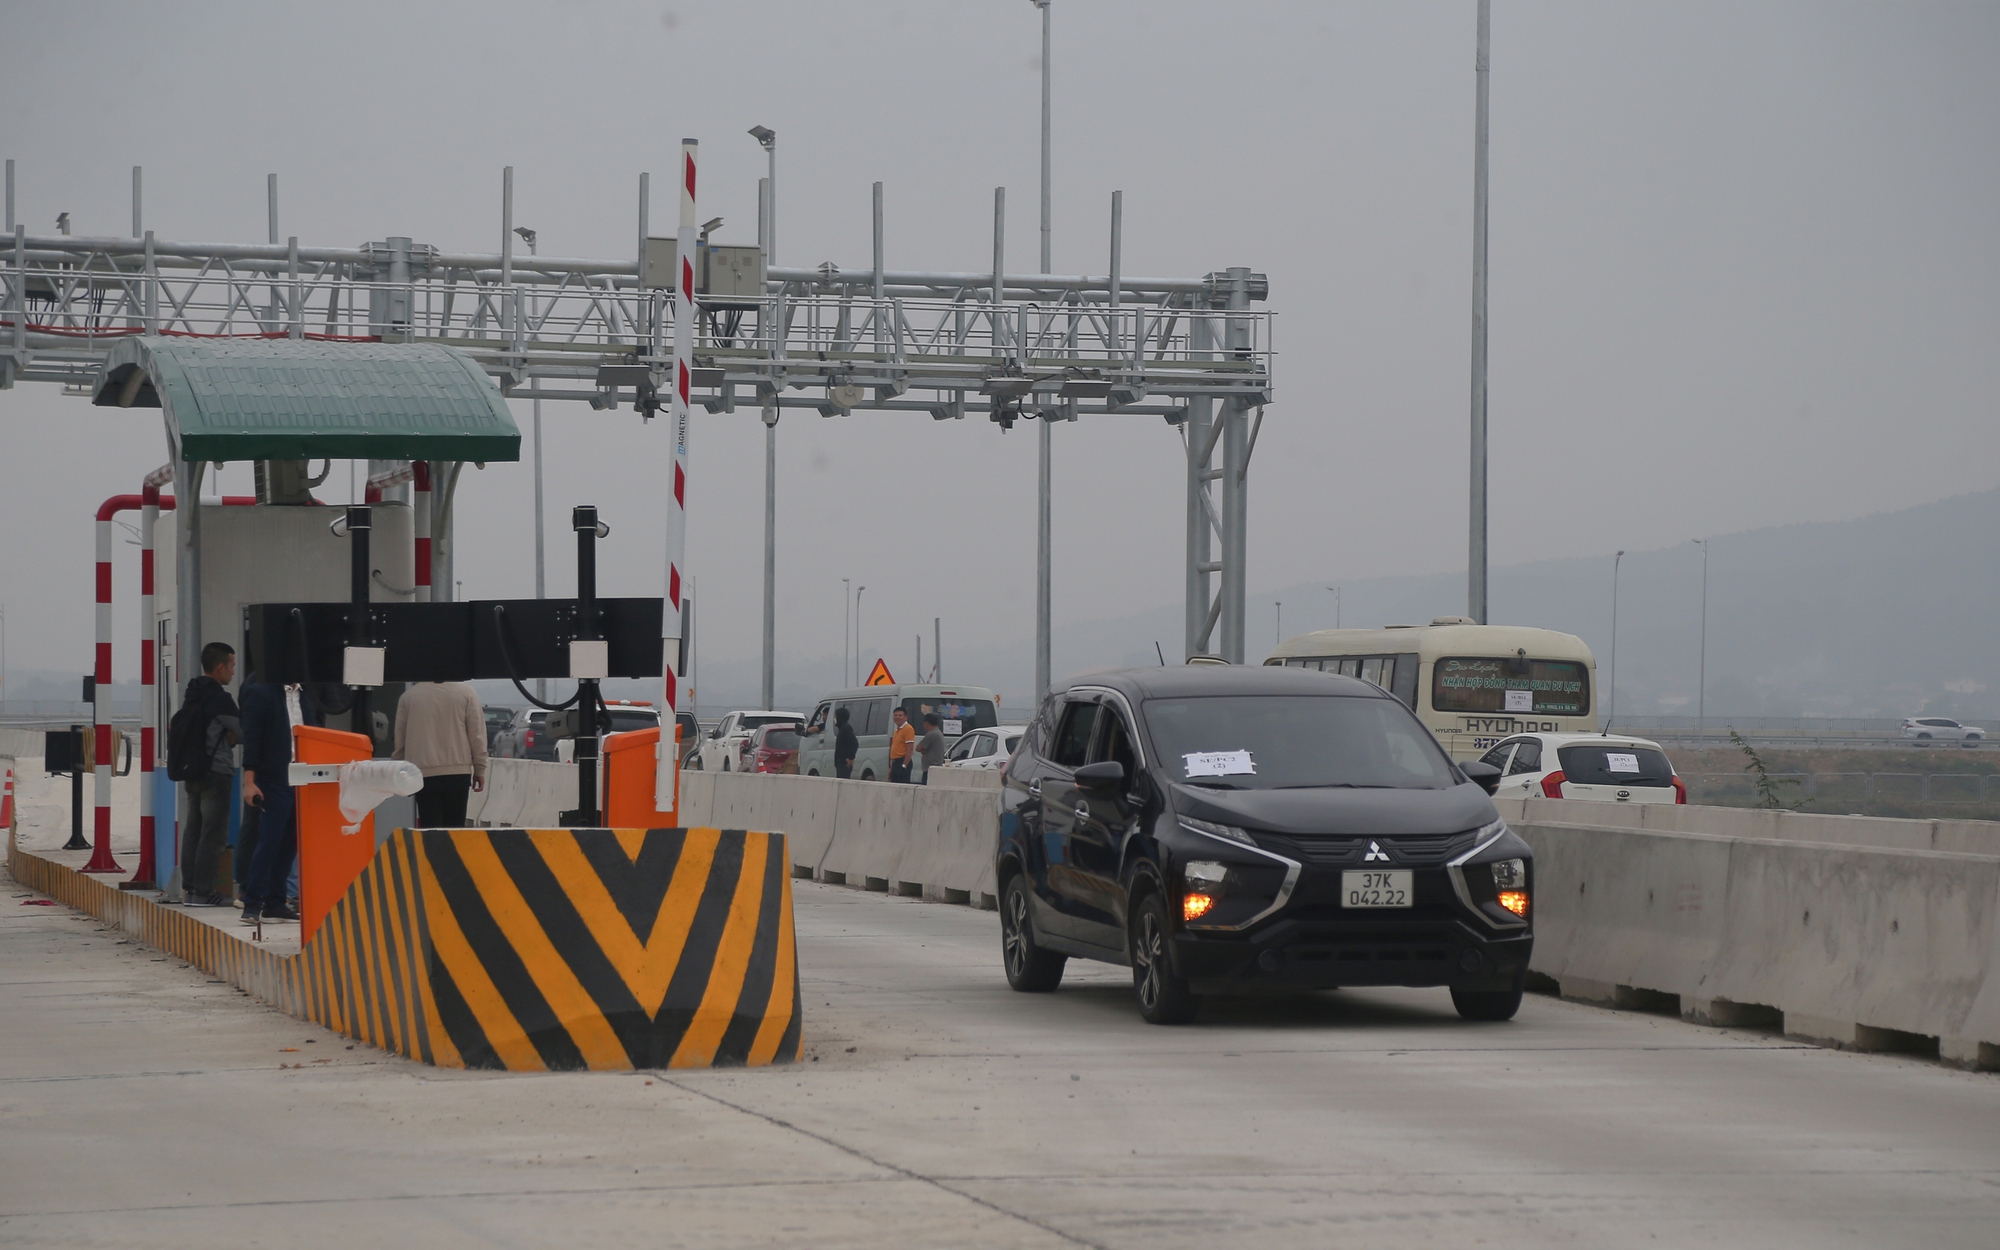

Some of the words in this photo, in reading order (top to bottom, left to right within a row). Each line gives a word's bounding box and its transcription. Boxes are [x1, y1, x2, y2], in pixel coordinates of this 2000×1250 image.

[1442, 674, 1466, 689] NHẬN
[1466, 676, 1484, 690] HỢP
[1507, 679, 1529, 691] THAM
[1530, 680, 1551, 691] QUAN
[1563, 681, 1581, 694] LỊCH
[1466, 719, 1559, 733] HYUNDAI
[1363, 873, 1392, 888] 37K
[1350, 890, 1405, 906] 042.22
